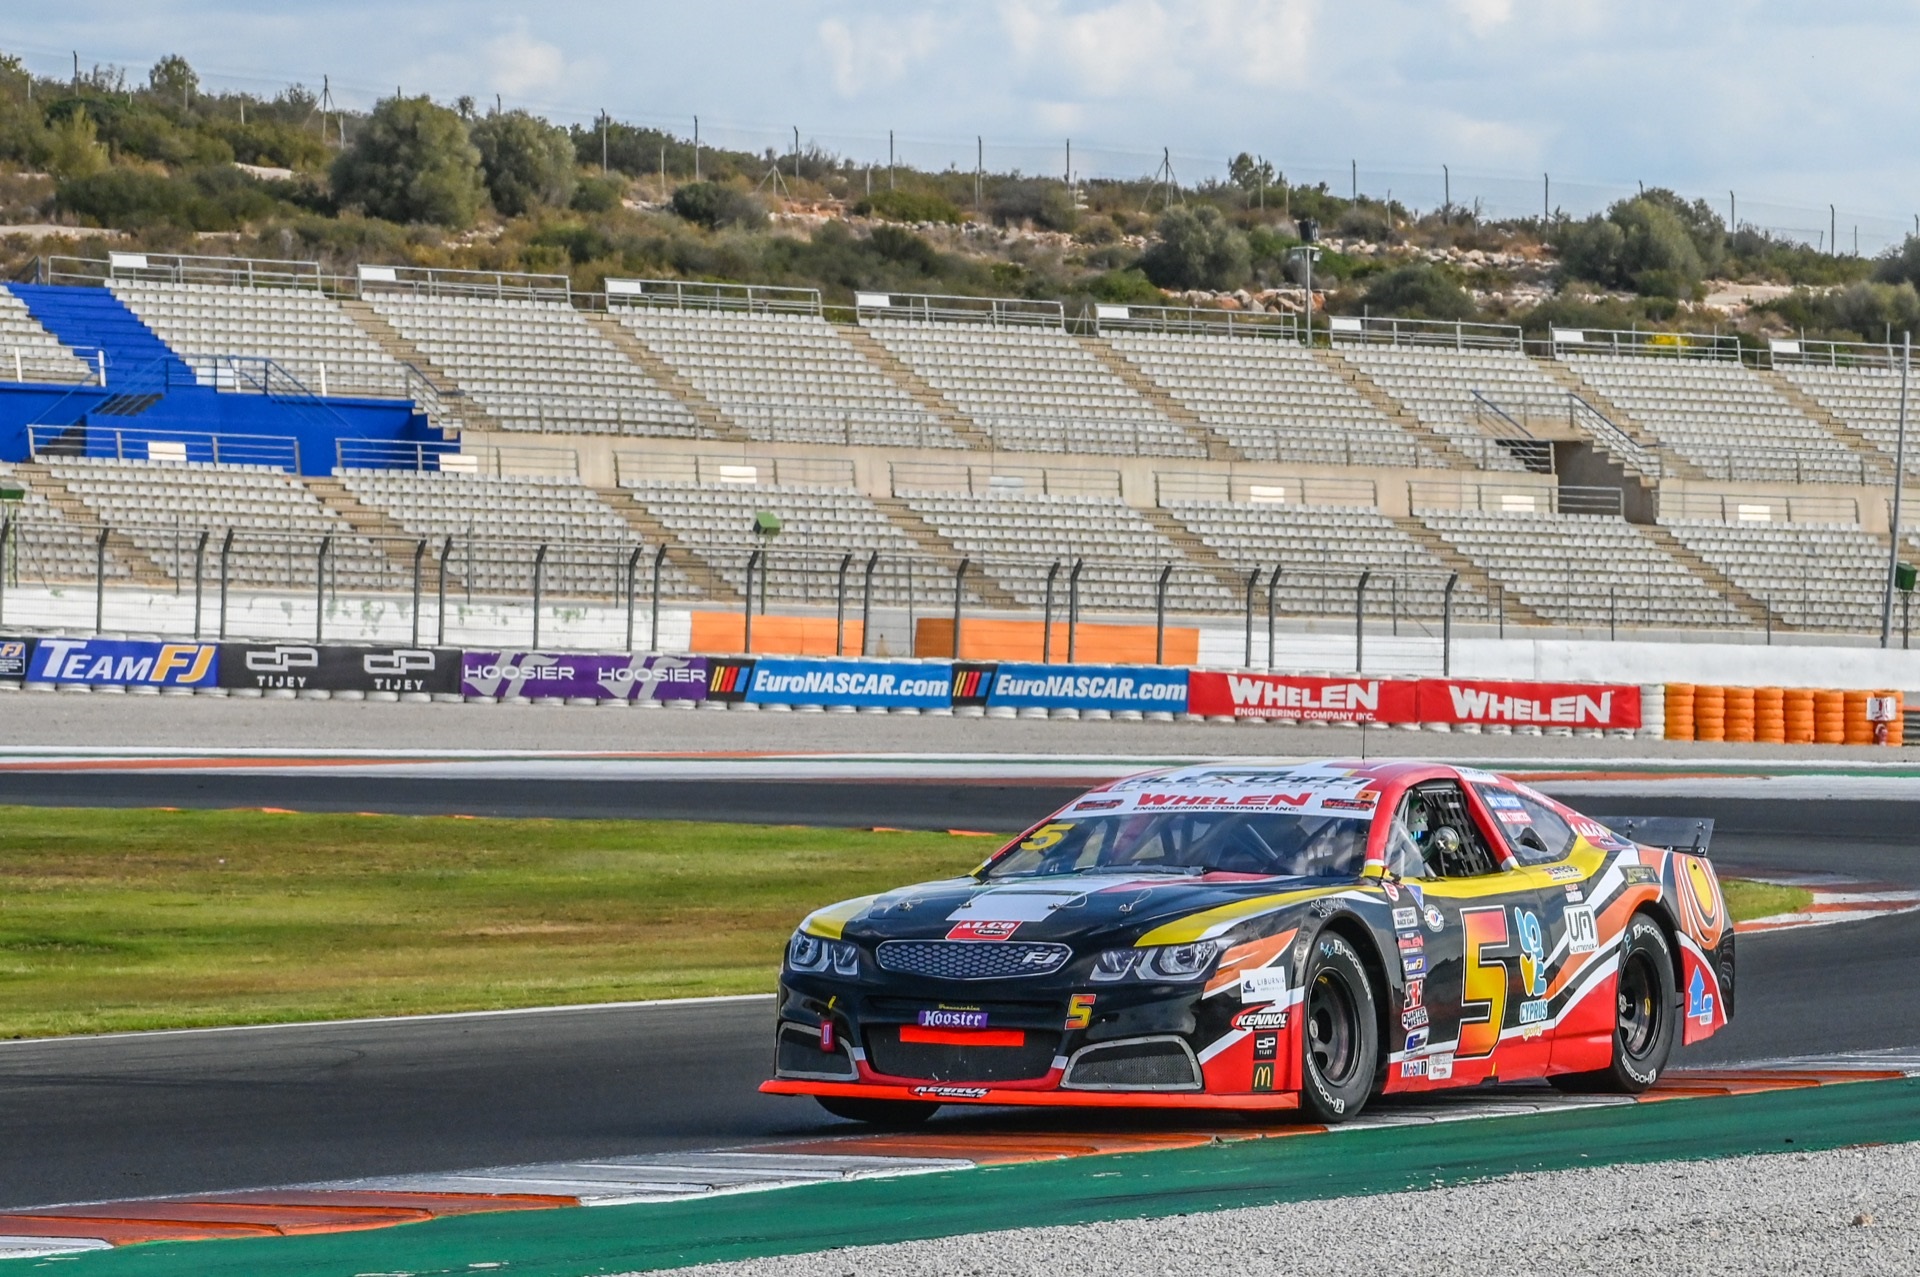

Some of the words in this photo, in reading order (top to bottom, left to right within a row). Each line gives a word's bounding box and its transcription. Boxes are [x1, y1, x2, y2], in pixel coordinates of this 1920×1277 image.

[257, 676, 306, 688] TIJEY
[464, 665, 575, 681] HOOSIER
[598, 666, 706, 683] HOOSIER
[374, 678, 423, 692] TIJEY
[754, 669, 949, 697] EuroNASCAR.com
[995, 673, 1187, 701] EuroNASCAR.com
[1227, 675, 1379, 711] WHELEN
[1448, 685, 1612, 723] WHELEN
[1234, 707, 1301, 719] ENGINEERING
[1304, 710, 1354, 721] COMPANY
[1137, 791, 1313, 806] WHELEN
[1020, 823, 1075, 851] 5
[1452, 904, 1510, 1062] 5
[921, 1010, 982, 1027] Hoosier
[1064, 993, 1097, 1030] 5
[1235, 1013, 1287, 1026] KENNOL
[1520, 1000, 1548, 1022] CYPRUS
